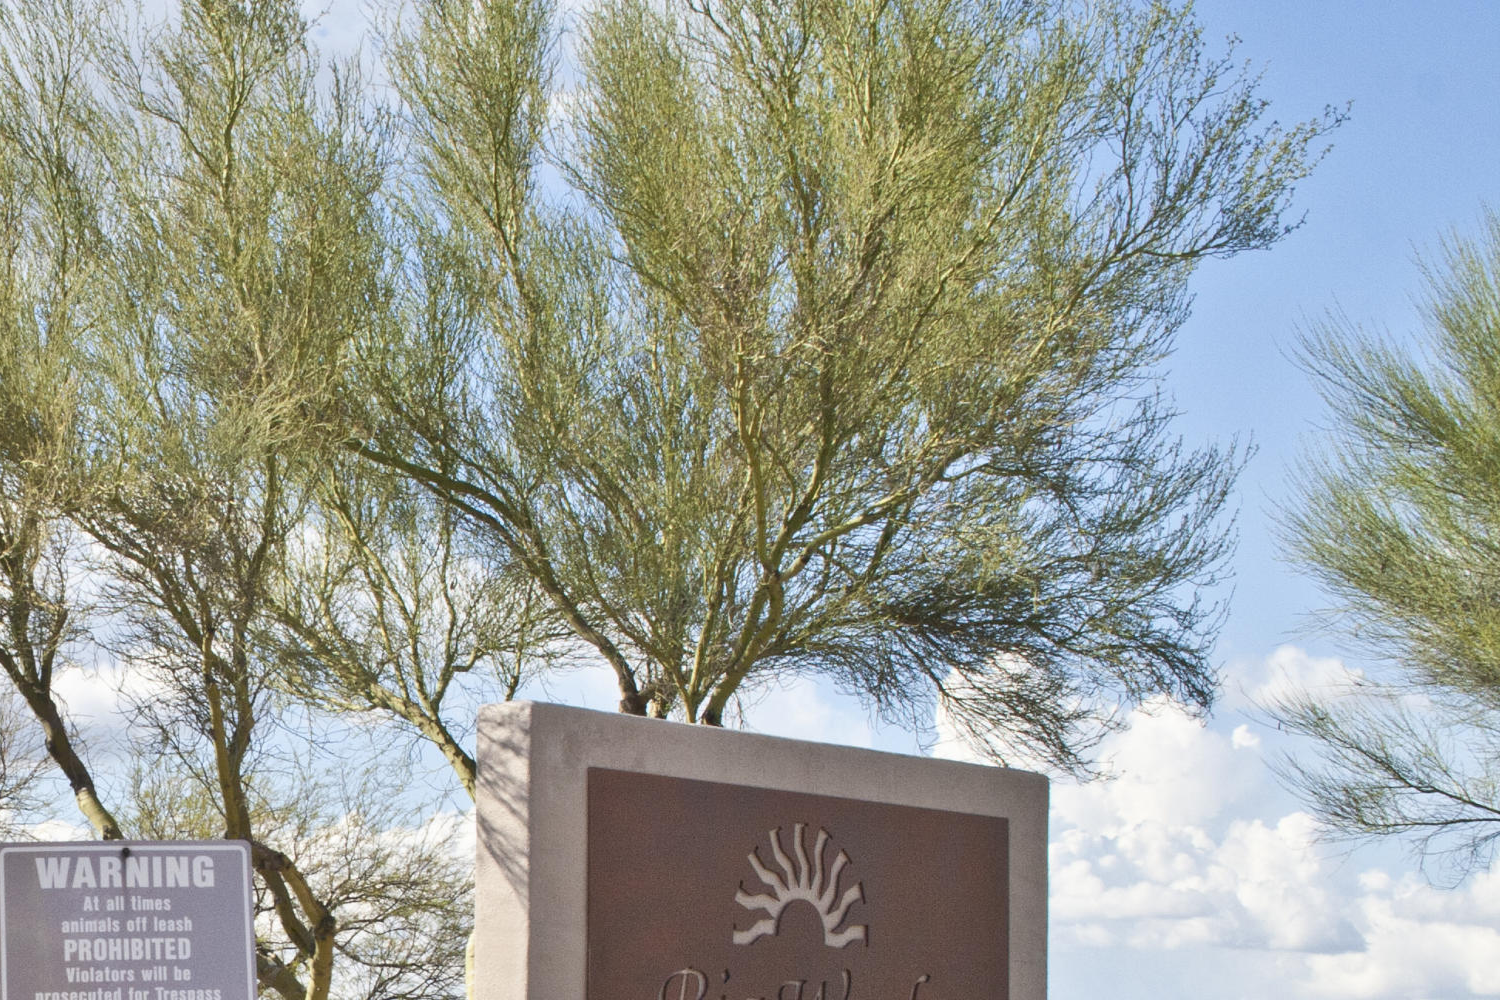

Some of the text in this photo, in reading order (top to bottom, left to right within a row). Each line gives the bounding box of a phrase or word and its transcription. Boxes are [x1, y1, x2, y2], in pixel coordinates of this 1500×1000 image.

[35, 855, 215, 889] WARNING
[83, 896, 172, 911] At all times
[61, 916, 193, 933] animals off leash
[63, 938, 192, 962] PROHIBITED
[66, 966, 192, 983] Violators will be
